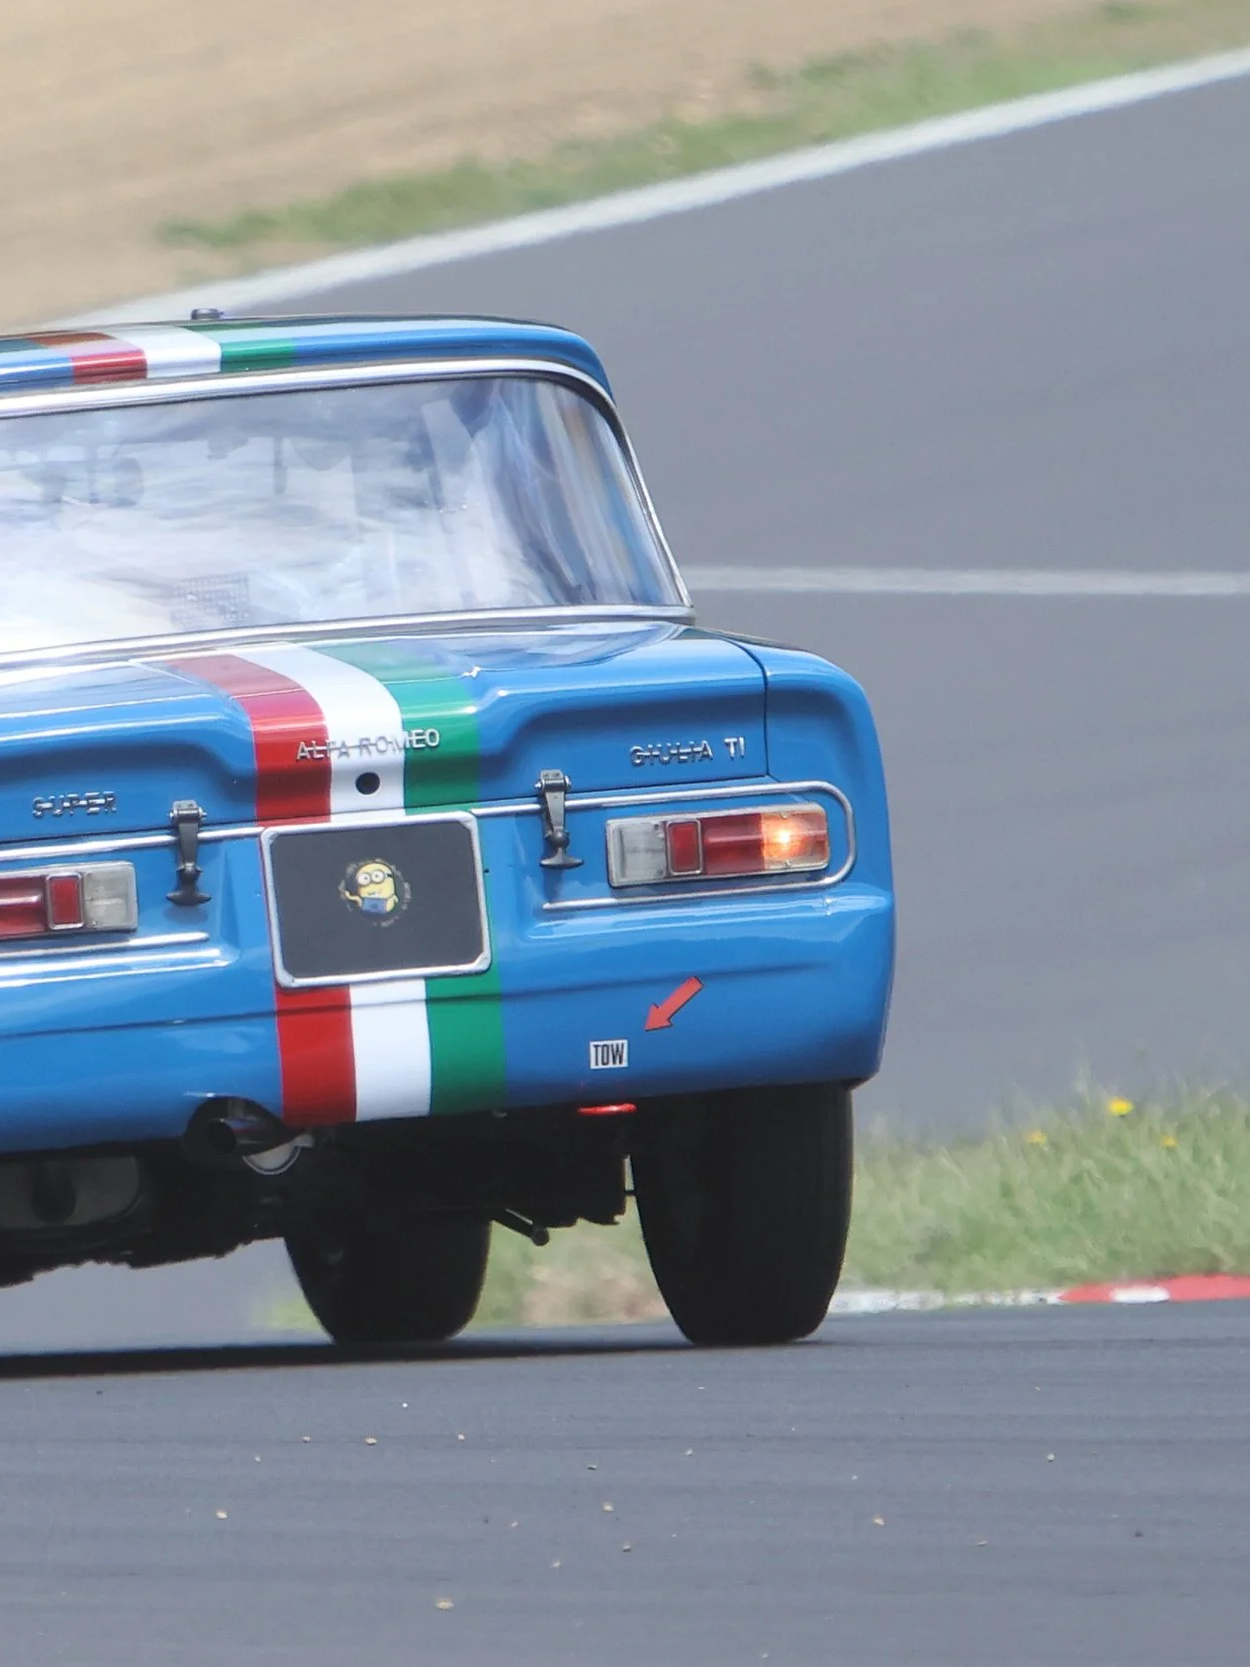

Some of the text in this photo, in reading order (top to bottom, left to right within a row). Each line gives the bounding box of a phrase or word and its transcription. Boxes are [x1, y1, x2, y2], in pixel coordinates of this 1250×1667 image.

[296, 728, 441, 760] ALFA ROMEO
[630, 735, 746, 766] GIULIA TI
[32, 790, 117, 817] SUPER
[592, 1042, 626, 1067] TOW
